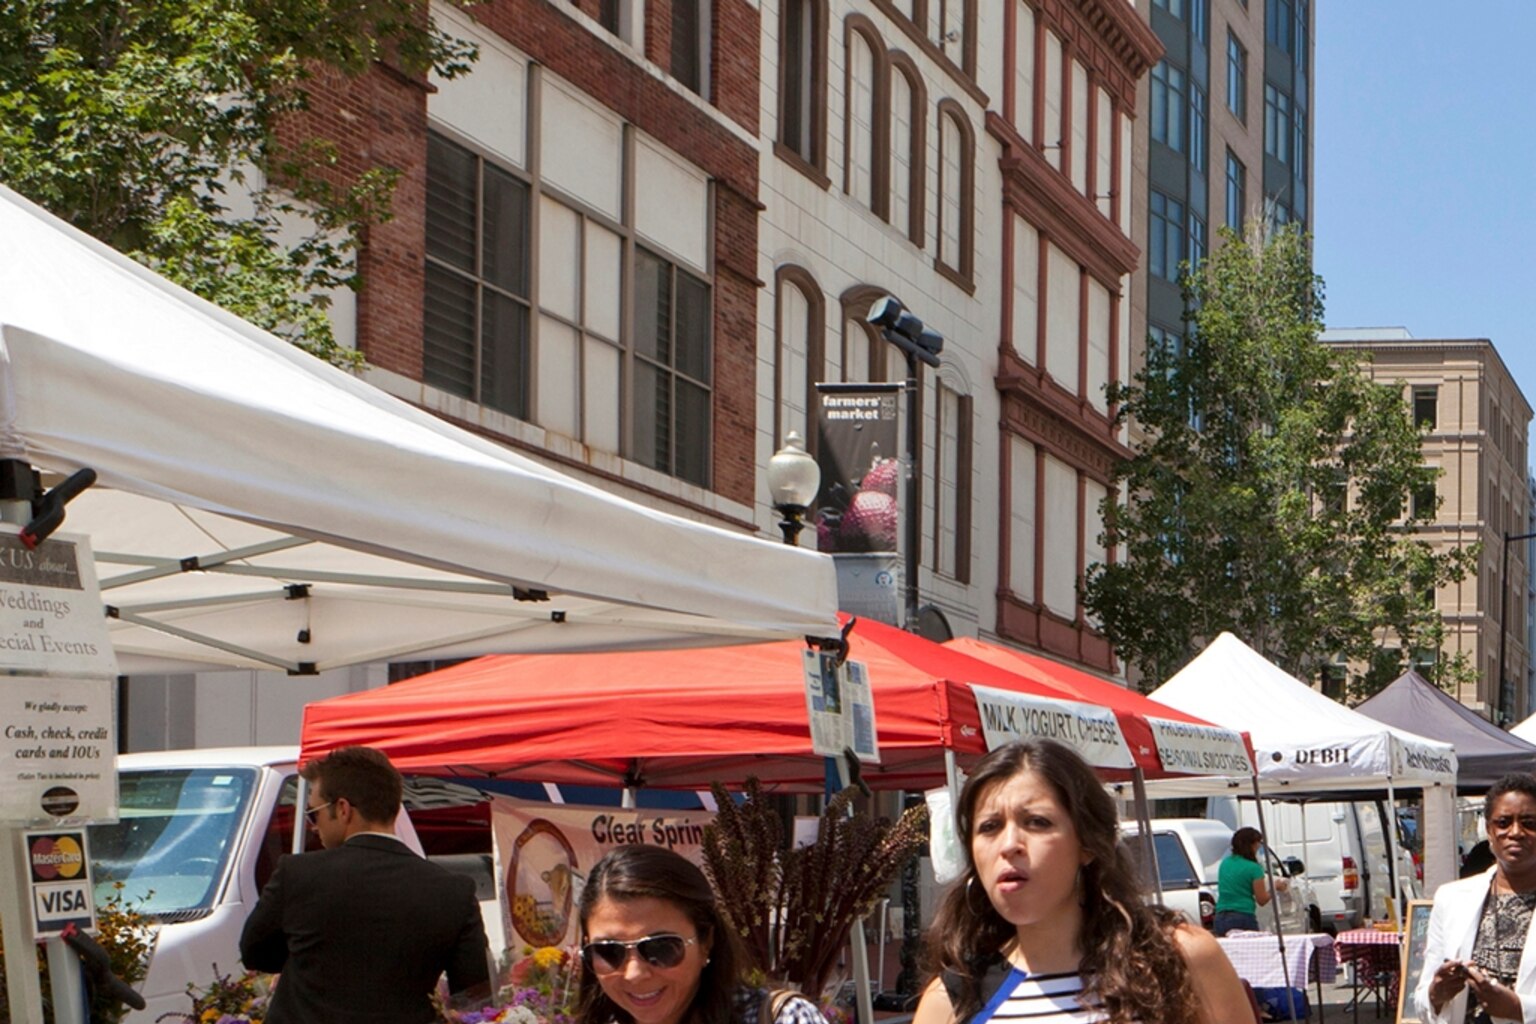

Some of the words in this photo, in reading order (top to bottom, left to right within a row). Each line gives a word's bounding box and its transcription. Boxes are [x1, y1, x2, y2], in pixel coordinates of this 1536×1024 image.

[823, 395, 881, 407] farmers'
[827, 408, 879, 419] market
[10, 548, 34, 570] US
[23, 618, 44, 629] and
[0, 633, 36, 652] ecial
[40, 634, 98, 656] Events
[5, 725, 38, 740] Cash,
[41, 726, 75, 741] check,
[78, 727, 108, 740] credit
[1022, 707, 1078, 744] YOGURT,
[1078, 716, 1119, 746] CHEESE
[15, 746, 46, 759] cards
[49, 746, 70, 759] and
[71, 745, 100, 759] IOUs
[1295, 747, 1351, 764] DEBIT
[591, 814, 645, 844] Clear
[652, 816, 703, 850] Sprin
[32, 852, 81, 865] MasterCard
[38, 889, 87, 914] VISA
